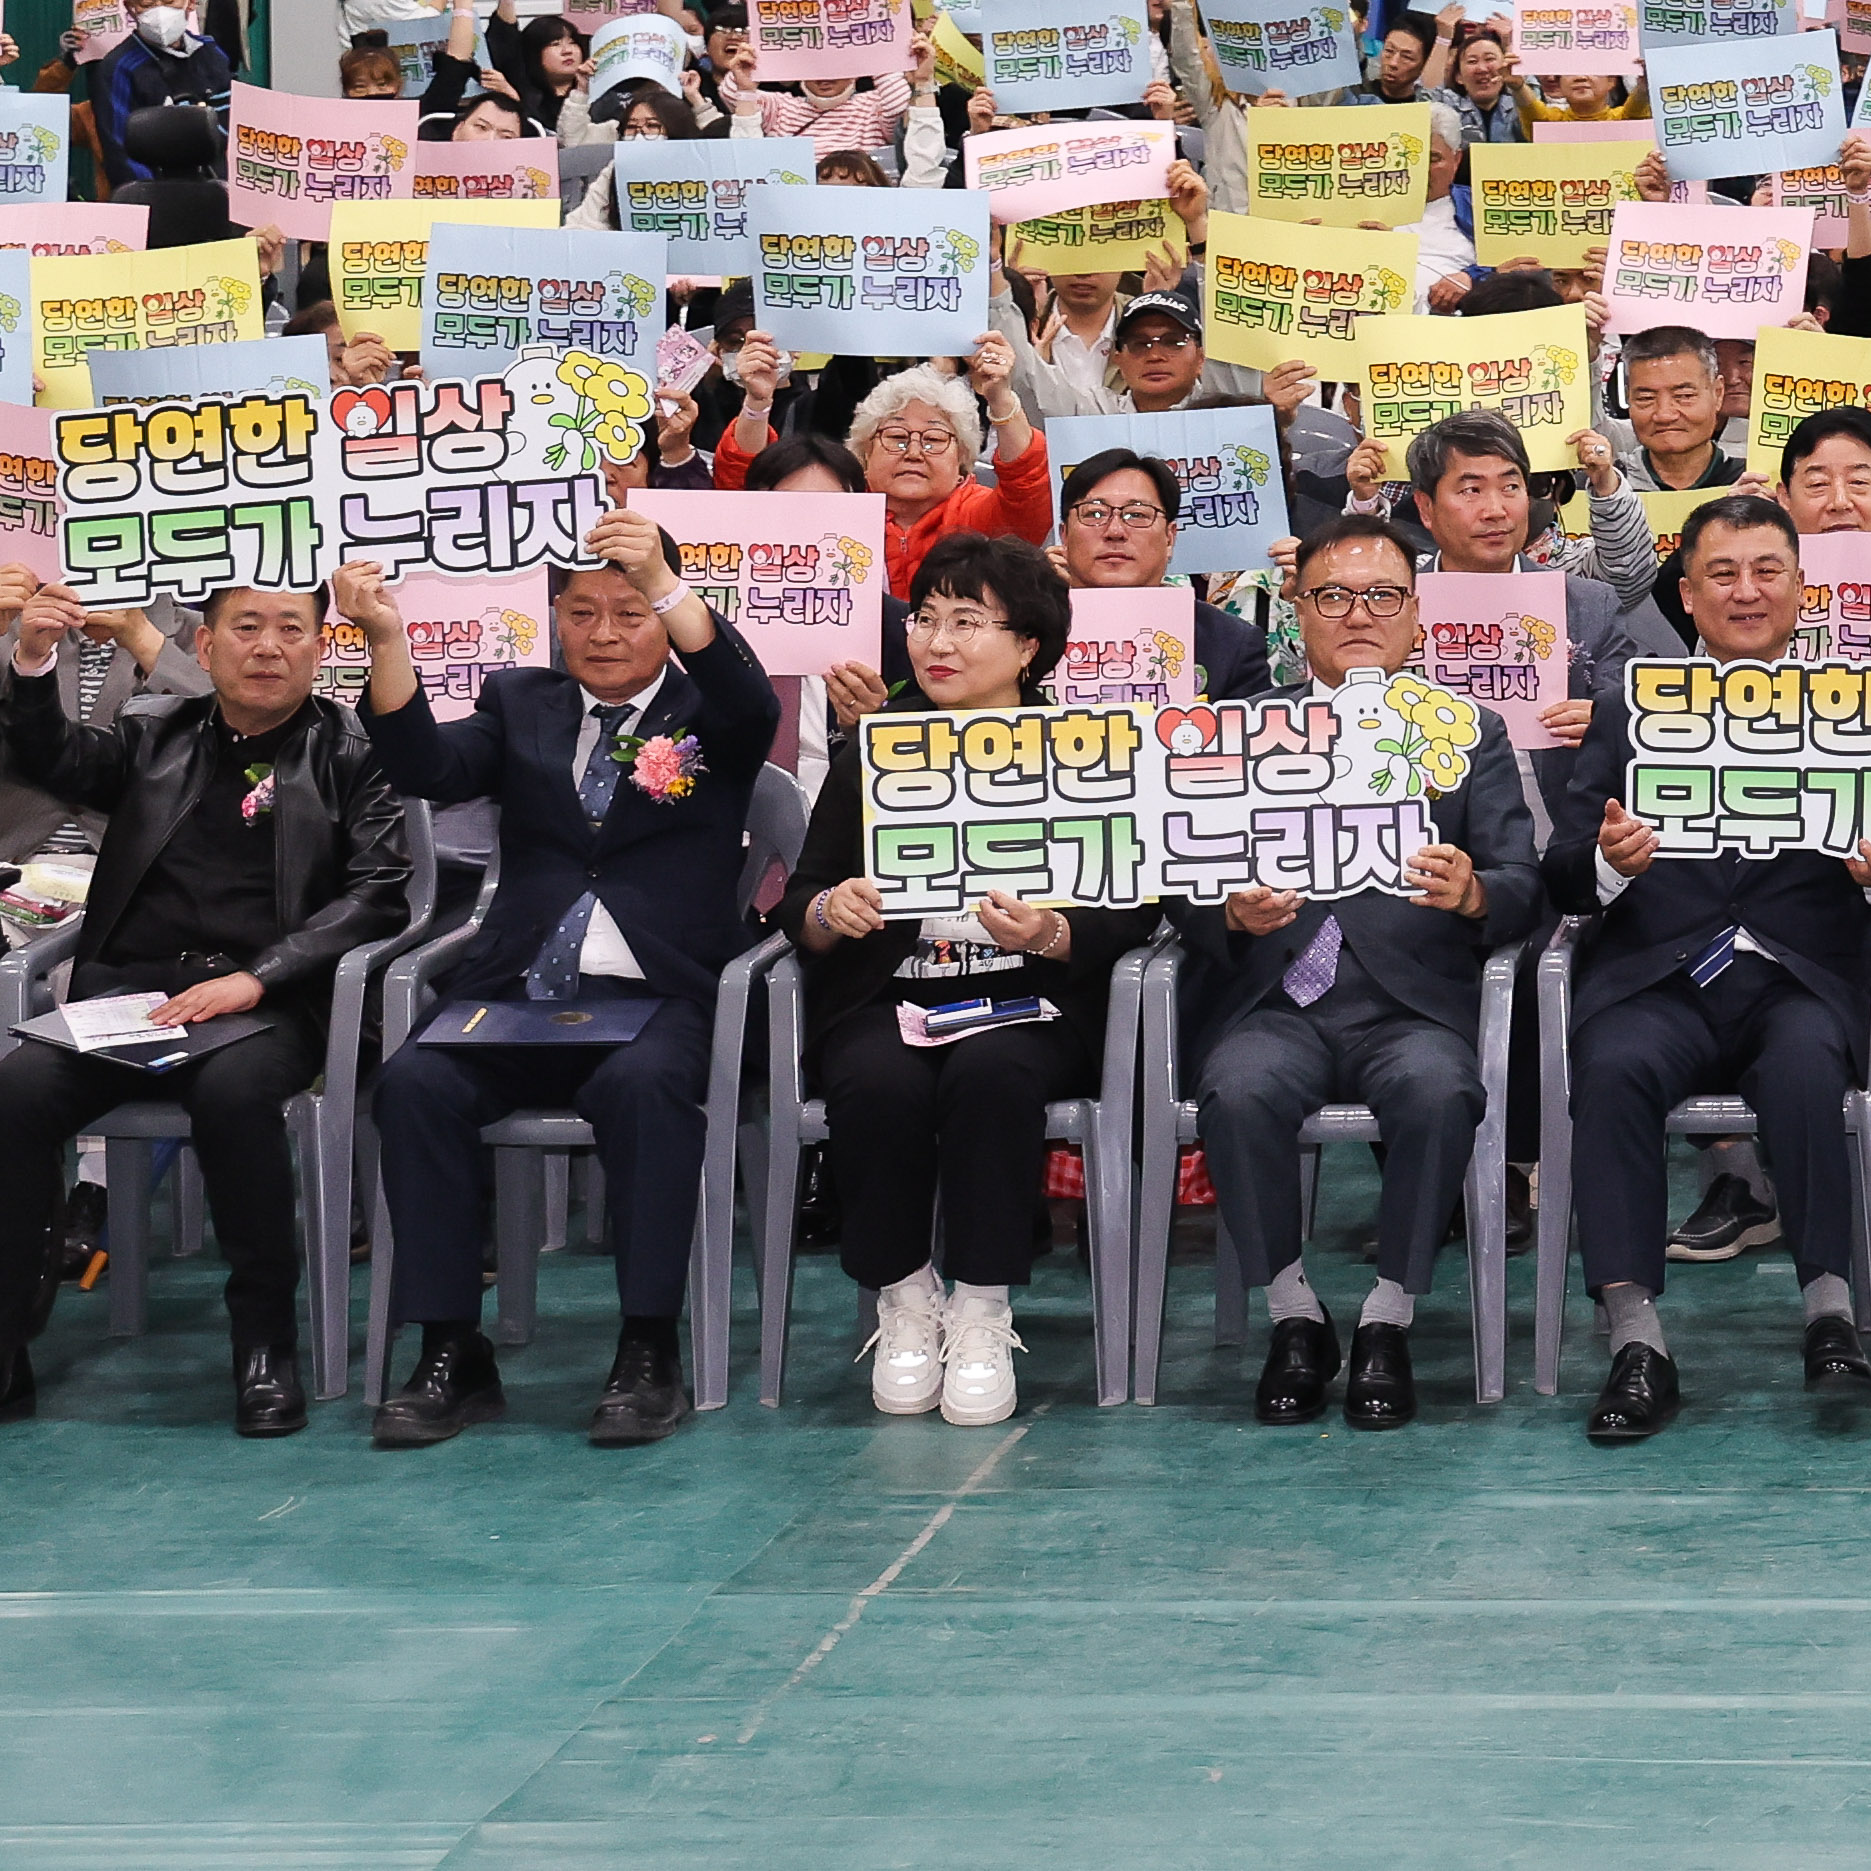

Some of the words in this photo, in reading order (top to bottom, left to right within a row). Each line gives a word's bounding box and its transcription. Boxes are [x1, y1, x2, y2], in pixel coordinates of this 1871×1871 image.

[760, 25, 823, 51] 모두가
[828, 18, 895, 48] 누리자
[992, 29, 1060, 53] 당연한
[1063, 24, 1108, 50] 일상
[1644, 8, 1706, 35] 모두가
[1711, 11, 1778, 35] 누리자
[993, 51, 1062, 83] 모두가
[1066, 49, 1133, 78] 누리자
[1660, 80, 1739, 112] 당연한
[1741, 77, 1794, 106] 일상
[1665, 110, 1742, 146] 모두가
[1747, 103, 1823, 136] 누리자
[237, 125, 301, 167] 당연한
[307, 138, 366, 171] 일상
[1258, 145, 1333, 171] 당연한
[1338, 144, 1387, 169] 일상
[236, 157, 300, 199] 모두가
[305, 174, 391, 201] 누리자
[1258, 173, 1332, 199] 모두가
[1337, 171, 1410, 198] 누리자
[760, 235, 856, 270] 당연한
[862, 235, 930, 270] 일상
[1619, 240, 1702, 269] 당연한
[1707, 243, 1762, 273] 일상
[437, 274, 532, 310] 당연한
[537, 278, 605, 317] 일상
[764, 275, 855, 310] 모두가
[861, 276, 961, 312] 누리자
[1613, 269, 1698, 302] 모두가
[1702, 274, 1783, 303] 누리자
[434, 312, 531, 349] 모두가
[537, 320, 639, 357] 누리자
[56, 394, 317, 503] 당연한
[331, 379, 512, 481] 일상
[63, 497, 323, 607] 모두가
[339, 475, 608, 574] 누리자
[868, 712, 1143, 810] 당연한
[1155, 699, 1338, 797] 일상
[871, 813, 1146, 910] 모두가
[1162, 802, 1434, 895] 누리자
